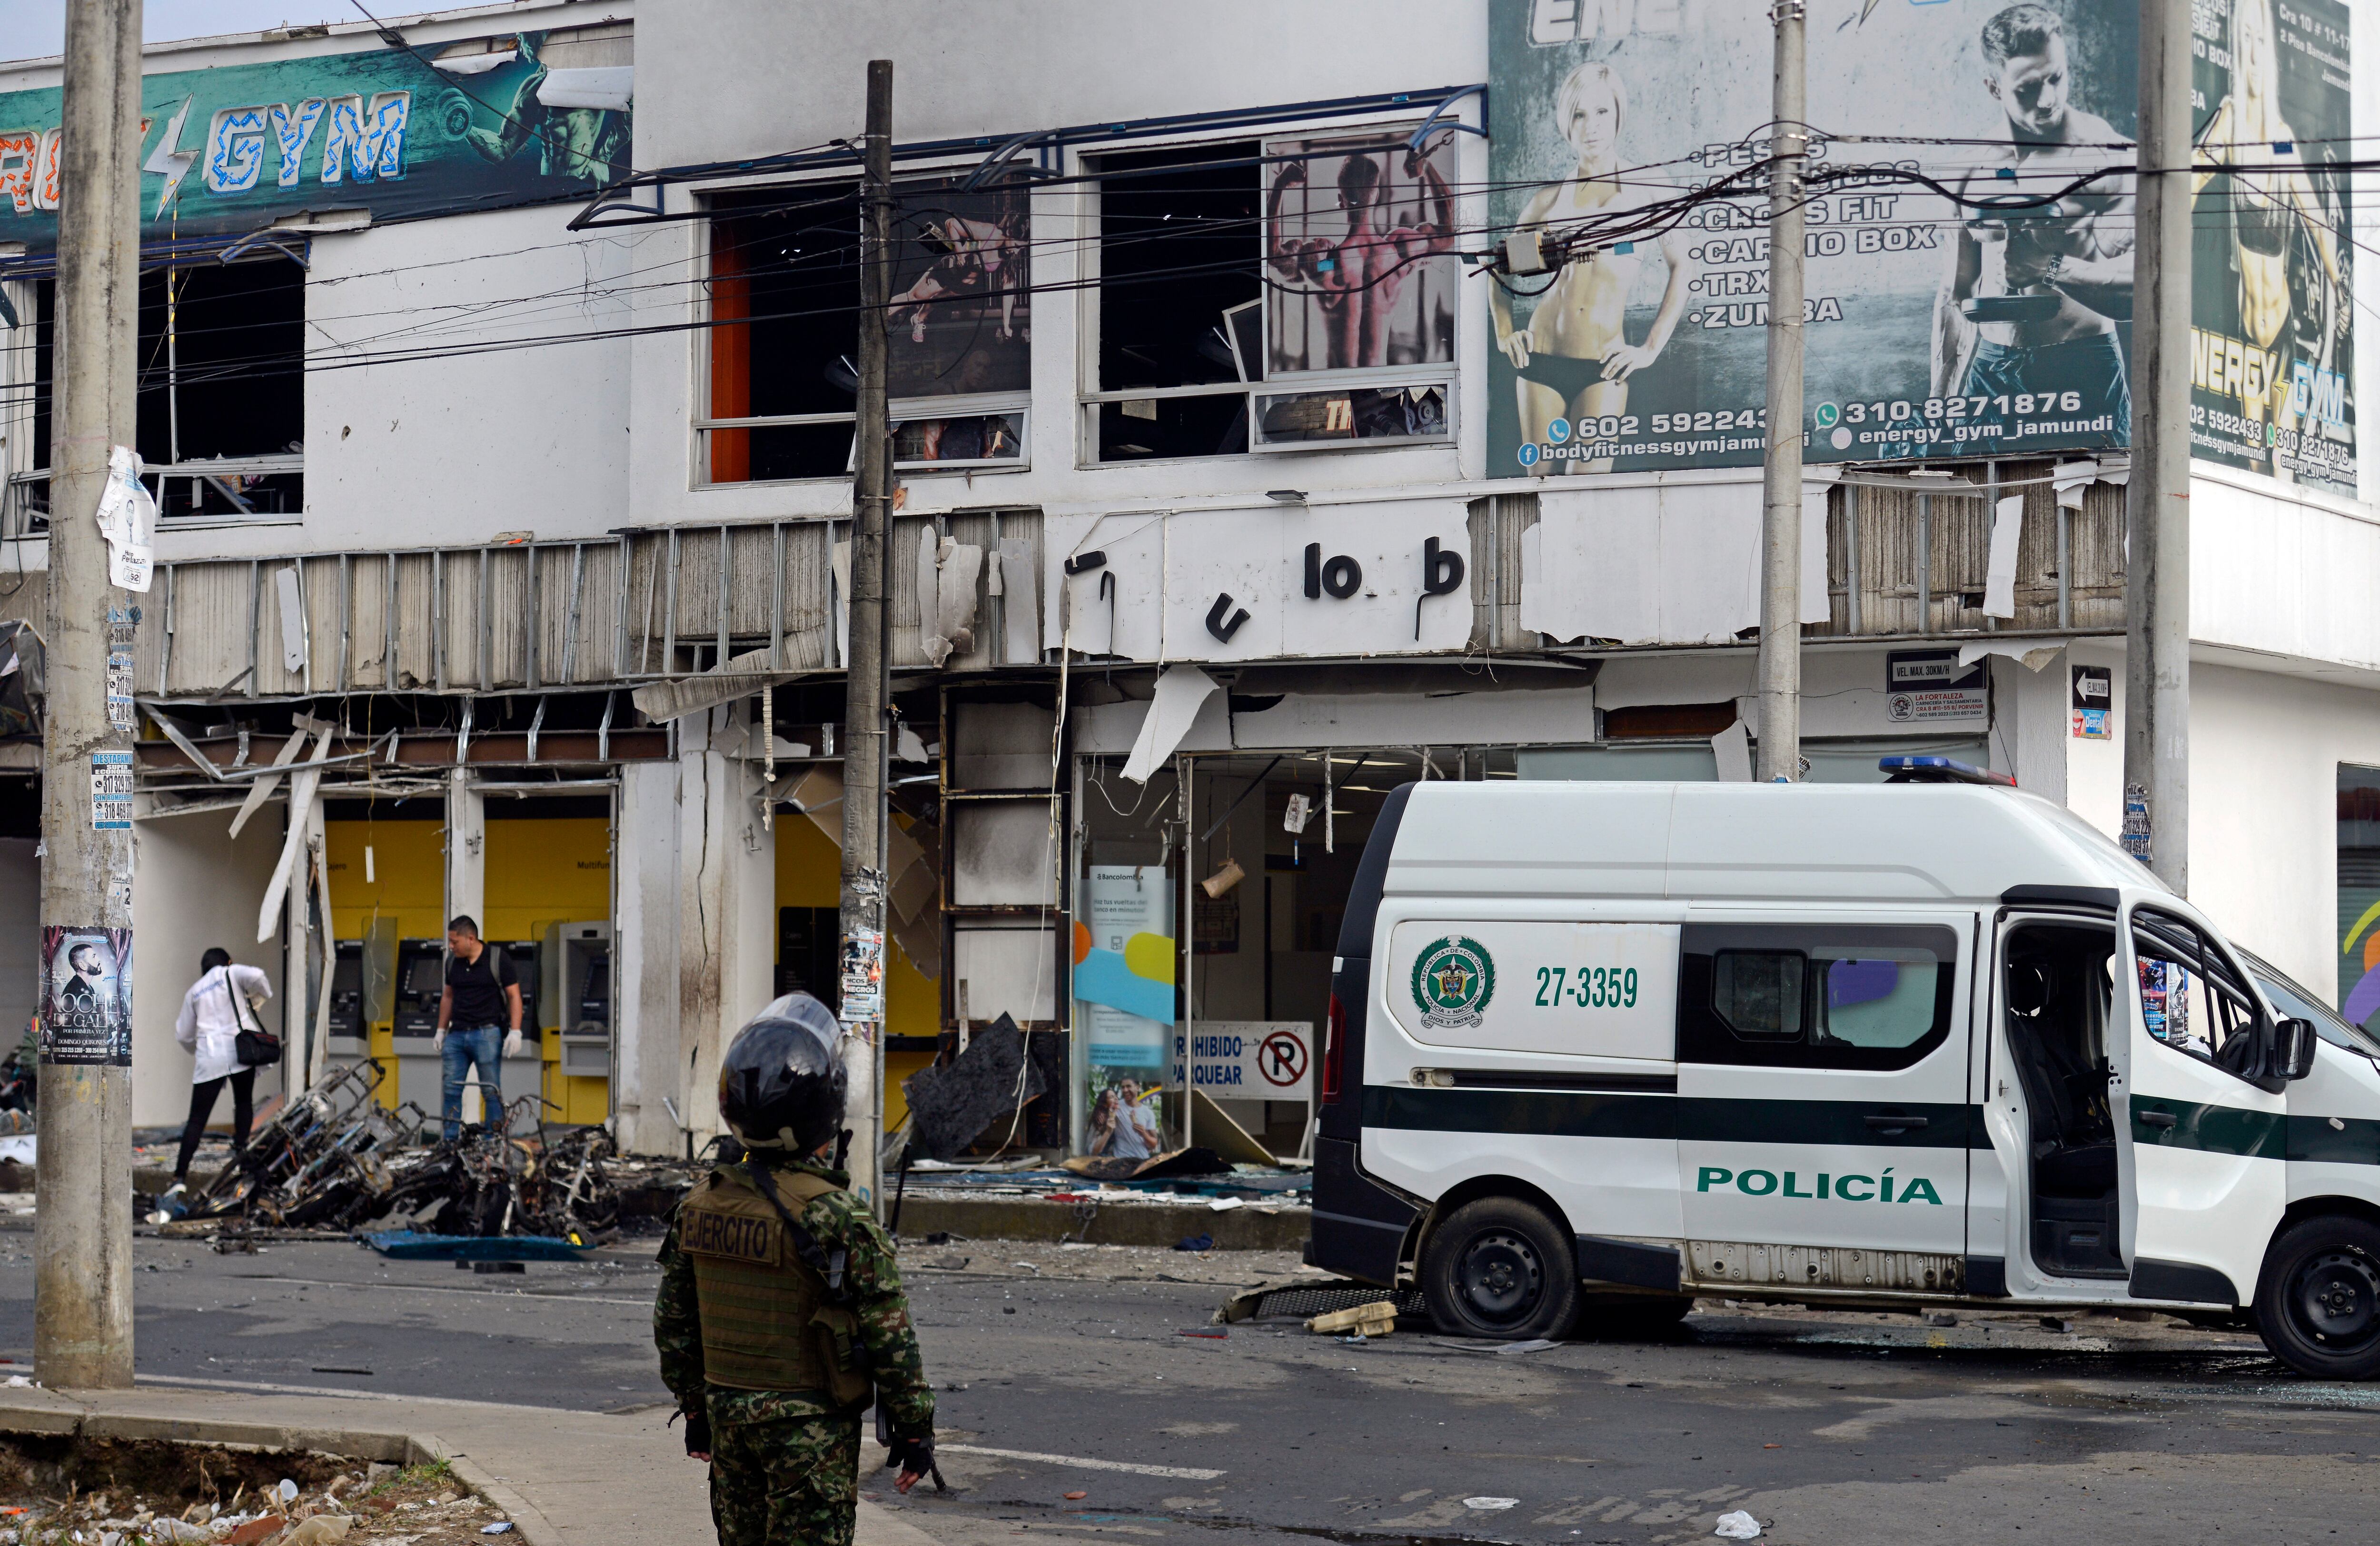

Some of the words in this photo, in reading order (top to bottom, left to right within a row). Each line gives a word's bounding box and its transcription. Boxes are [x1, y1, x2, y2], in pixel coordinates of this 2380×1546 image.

[2299, 13, 2312, 32] 10
[2288, 31, 2305, 52] Piso
[2209, 44, 2233, 71] BOX
[202, 90, 411, 193] GYM
[1704, 140, 1827, 168] PESS
[1704, 199, 1829, 232] CROS
[1840, 193, 1899, 222] FIT
[1704, 231, 1845, 264] CARIO
[1856, 224, 1936, 254] BOX
[1702, 269, 1769, 296] TRX
[2292, 358, 2345, 427] GYM
[1846, 400, 1911, 423] 310
[1924, 391, 2082, 420] 8271876
[1578, 415, 1639, 438] 602
[1859, 415, 2113, 445] energy_gym_jamundi
[2209, 409, 2261, 441] 5922433
[2276, 427, 2298, 450] 310
[2301, 435, 2349, 465] 8271876
[1897, 667, 1909, 677] VEL.
[1910, 666, 1924, 676] MAX.
[1926, 665, 1949, 675] 30KM/H
[116, 702, 125, 721] 318
[2085, 716, 2102, 728] Dental
[103, 775, 113, 793] 317
[114, 775, 124, 793] 329
[95, 794, 106, 802] SIN
[104, 802, 115, 819] 318
[116, 803, 126, 819] 469
[2132, 840, 2142, 853] 469
[1463, 950, 1485, 981] COLOMBIA
[1535, 967, 1638, 1008] 27-3359
[52, 993, 118, 1014] NOCHE
[1425, 996, 1444, 1014] POLICÍA
[1453, 994, 1480, 1015] NACIONAL
[53, 1013, 71, 1027] DE
[73, 1014, 115, 1028] GALA
[1428, 1015, 1444, 1024] DIOS
[1453, 1014, 1476, 1024] PATRIA
[1696, 1166, 1944, 1205] POLICÍA
[684, 1209, 768, 1258] EJERCITO
